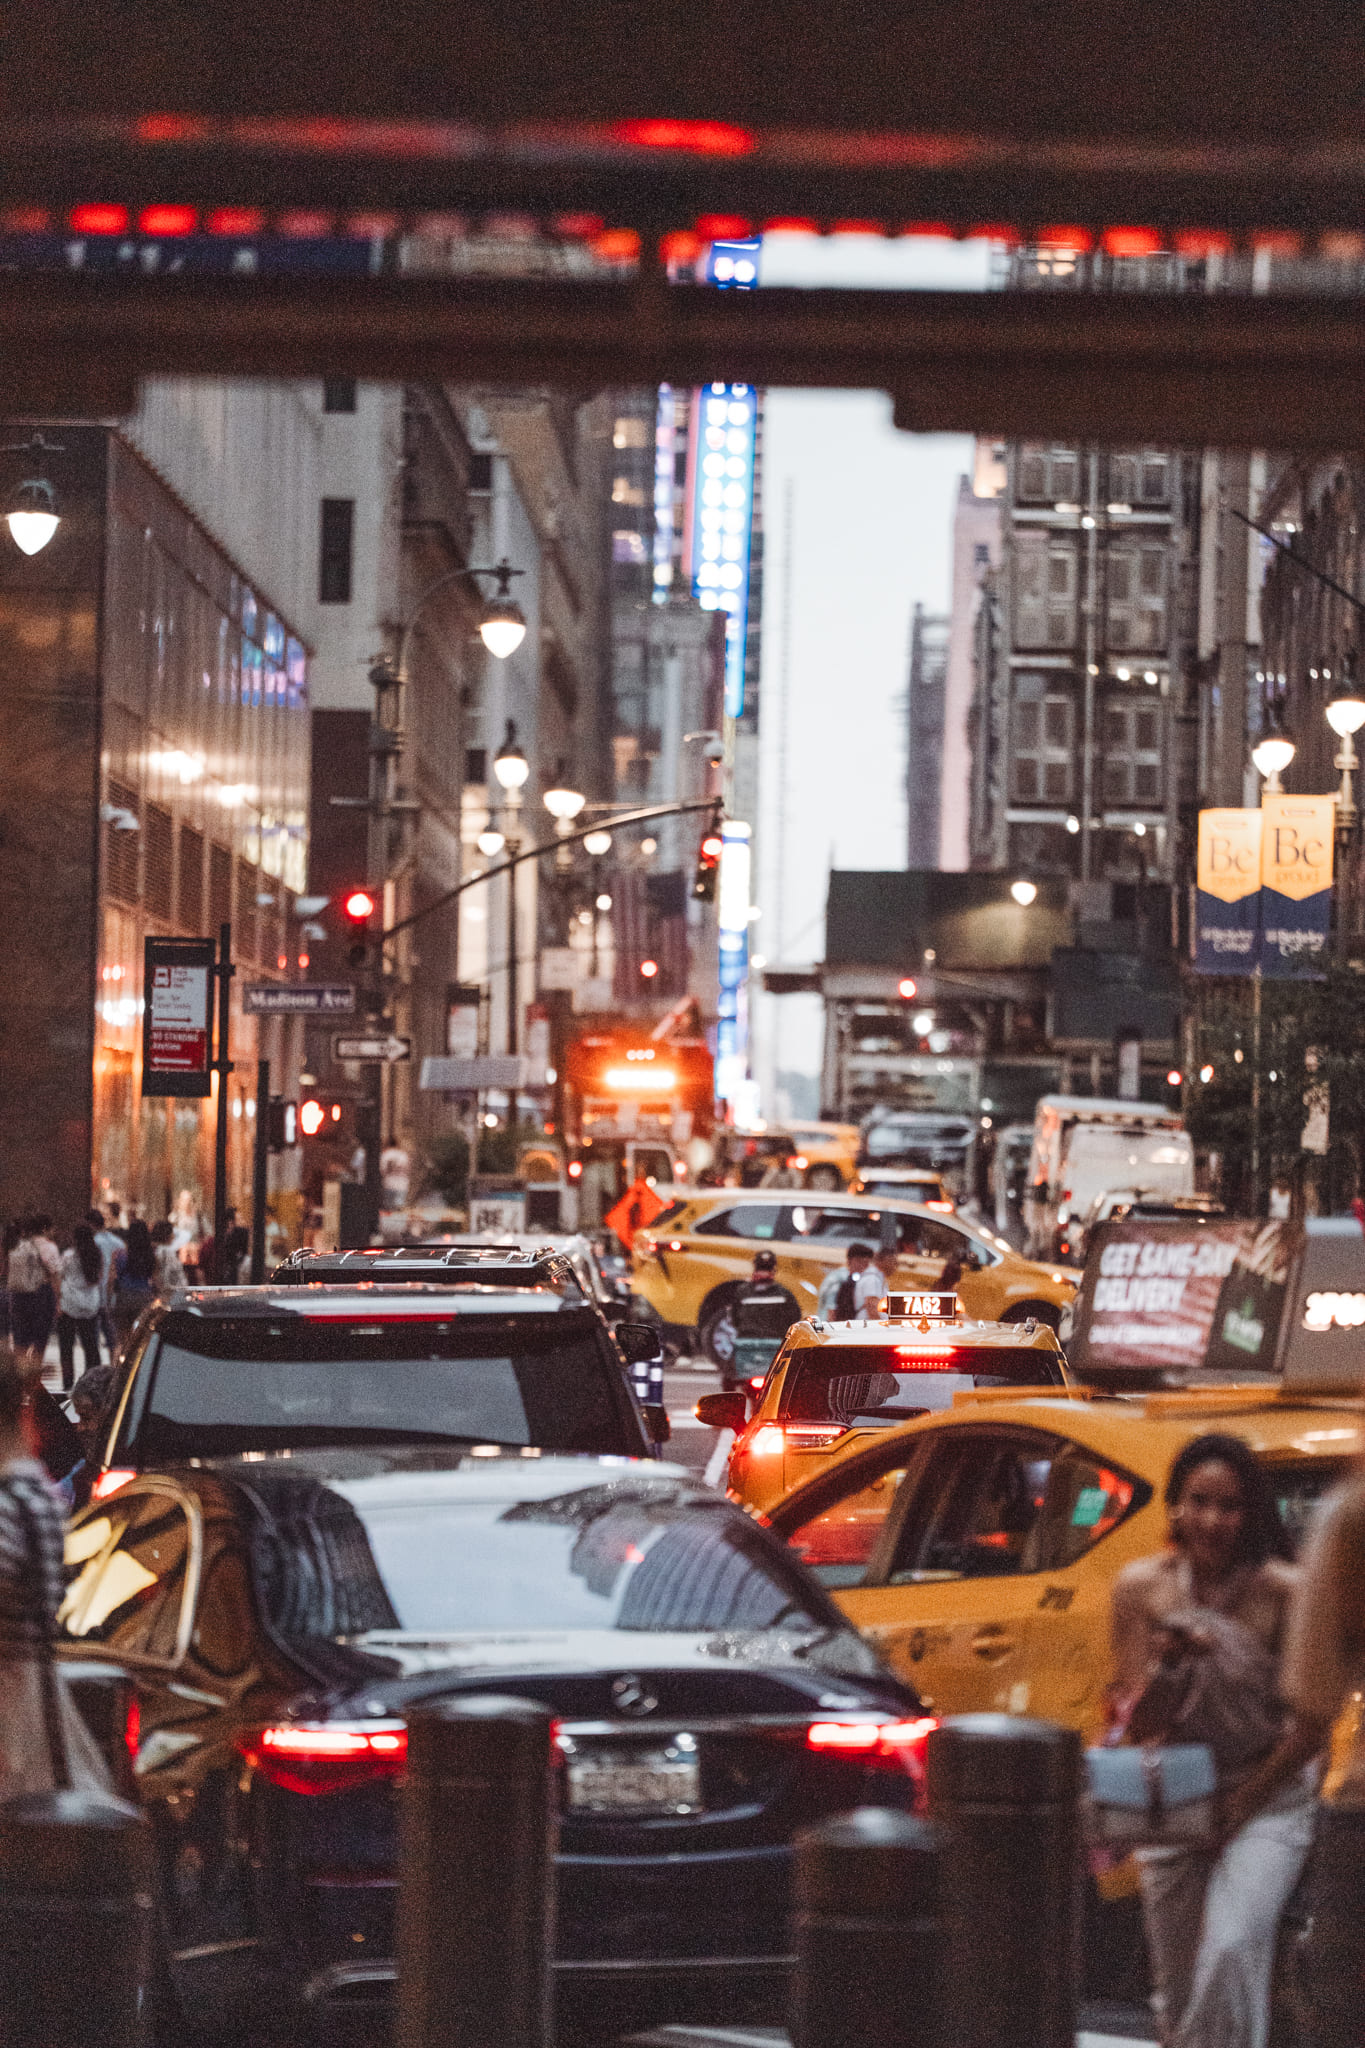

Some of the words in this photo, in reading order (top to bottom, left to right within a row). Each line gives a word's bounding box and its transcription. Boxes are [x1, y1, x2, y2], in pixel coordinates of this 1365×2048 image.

[1208, 837, 1254, 875] Be
[1274, 827, 1323, 867] Be
[250, 991, 318, 1008] Madison
[323, 990, 351, 1008] Ave
[1100, 1243, 1141, 1276] GET
[1136, 1242, 1240, 1277] SAME-DAY
[903, 1296, 941, 1315] 7A62
[1093, 1277, 1189, 1312] DELIVERY
